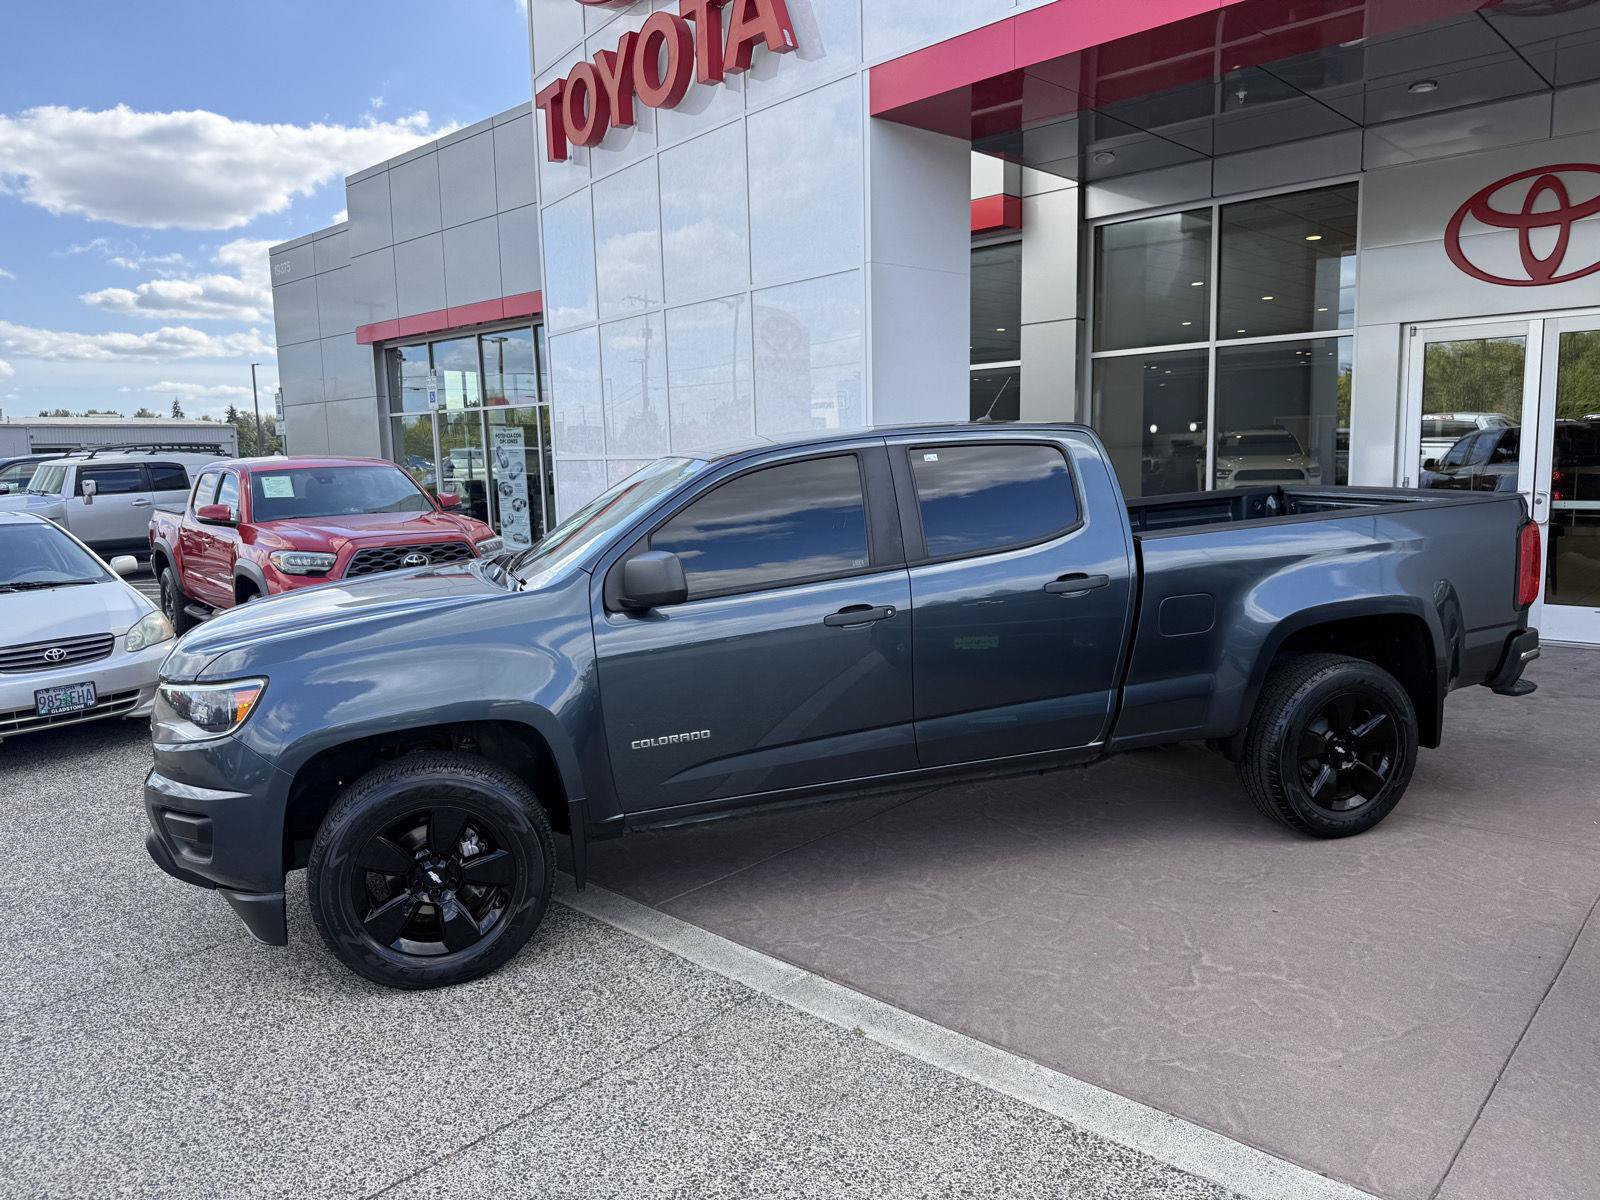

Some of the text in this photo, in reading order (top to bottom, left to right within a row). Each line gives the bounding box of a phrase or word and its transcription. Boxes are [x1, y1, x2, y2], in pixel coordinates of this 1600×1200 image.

[536, 0, 798, 163] TOYOTA
[39, 694, 62, 709] 985
[70, 689, 93, 704] EHA
[51, 704, 84, 714] GLADSTONE
[631, 730, 711, 749] COLORADO
